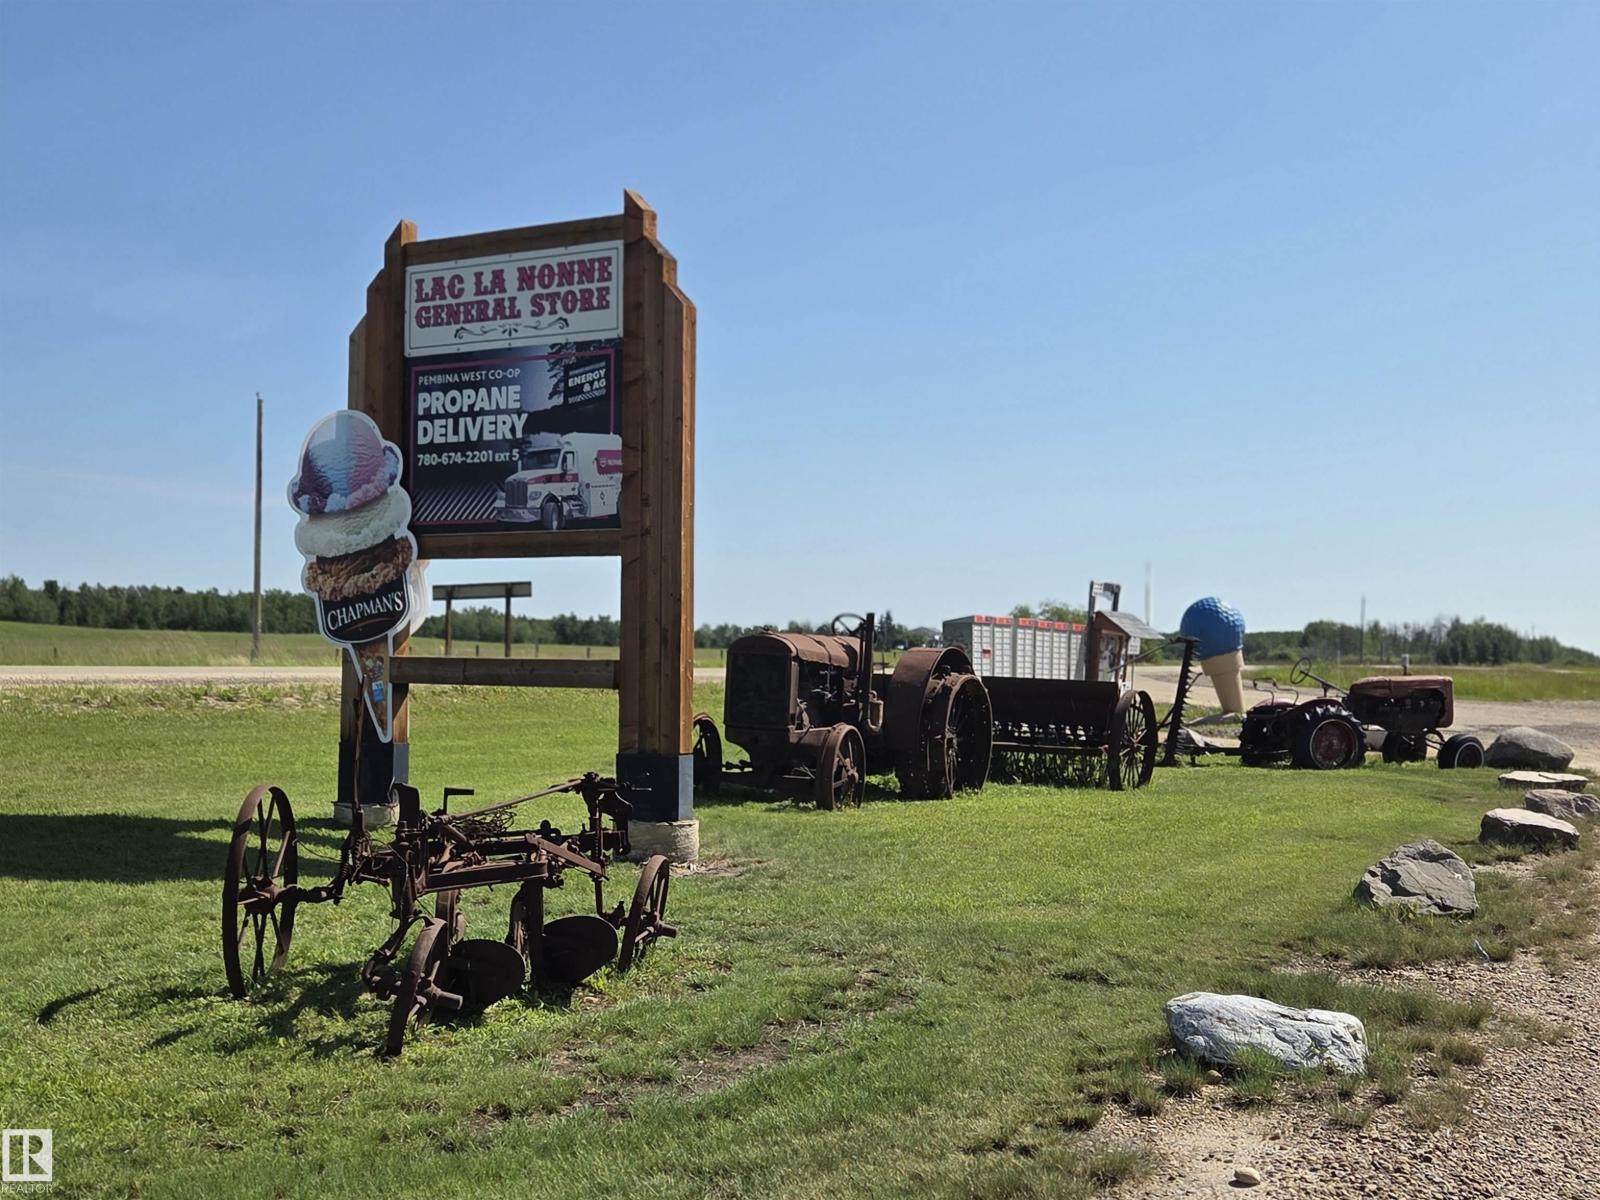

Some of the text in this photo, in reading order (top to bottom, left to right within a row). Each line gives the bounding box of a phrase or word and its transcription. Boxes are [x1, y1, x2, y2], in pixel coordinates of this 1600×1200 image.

[415, 256, 612, 303] LAC LA NONNE
[415, 286, 610, 328] GENERAL STORE
[418, 368, 521, 386] PEMBINA WEST CO-OP
[568, 368, 606, 387] ENERGY
[582, 379, 606, 393] & AG
[417, 385, 521, 416] PROPANE
[417, 413, 528, 445] DELIVERY
[417, 450, 494, 466] 780-674-2201
[511, 449, 520, 461] 5
[326, 592, 404, 631] CHAPMAN'S
